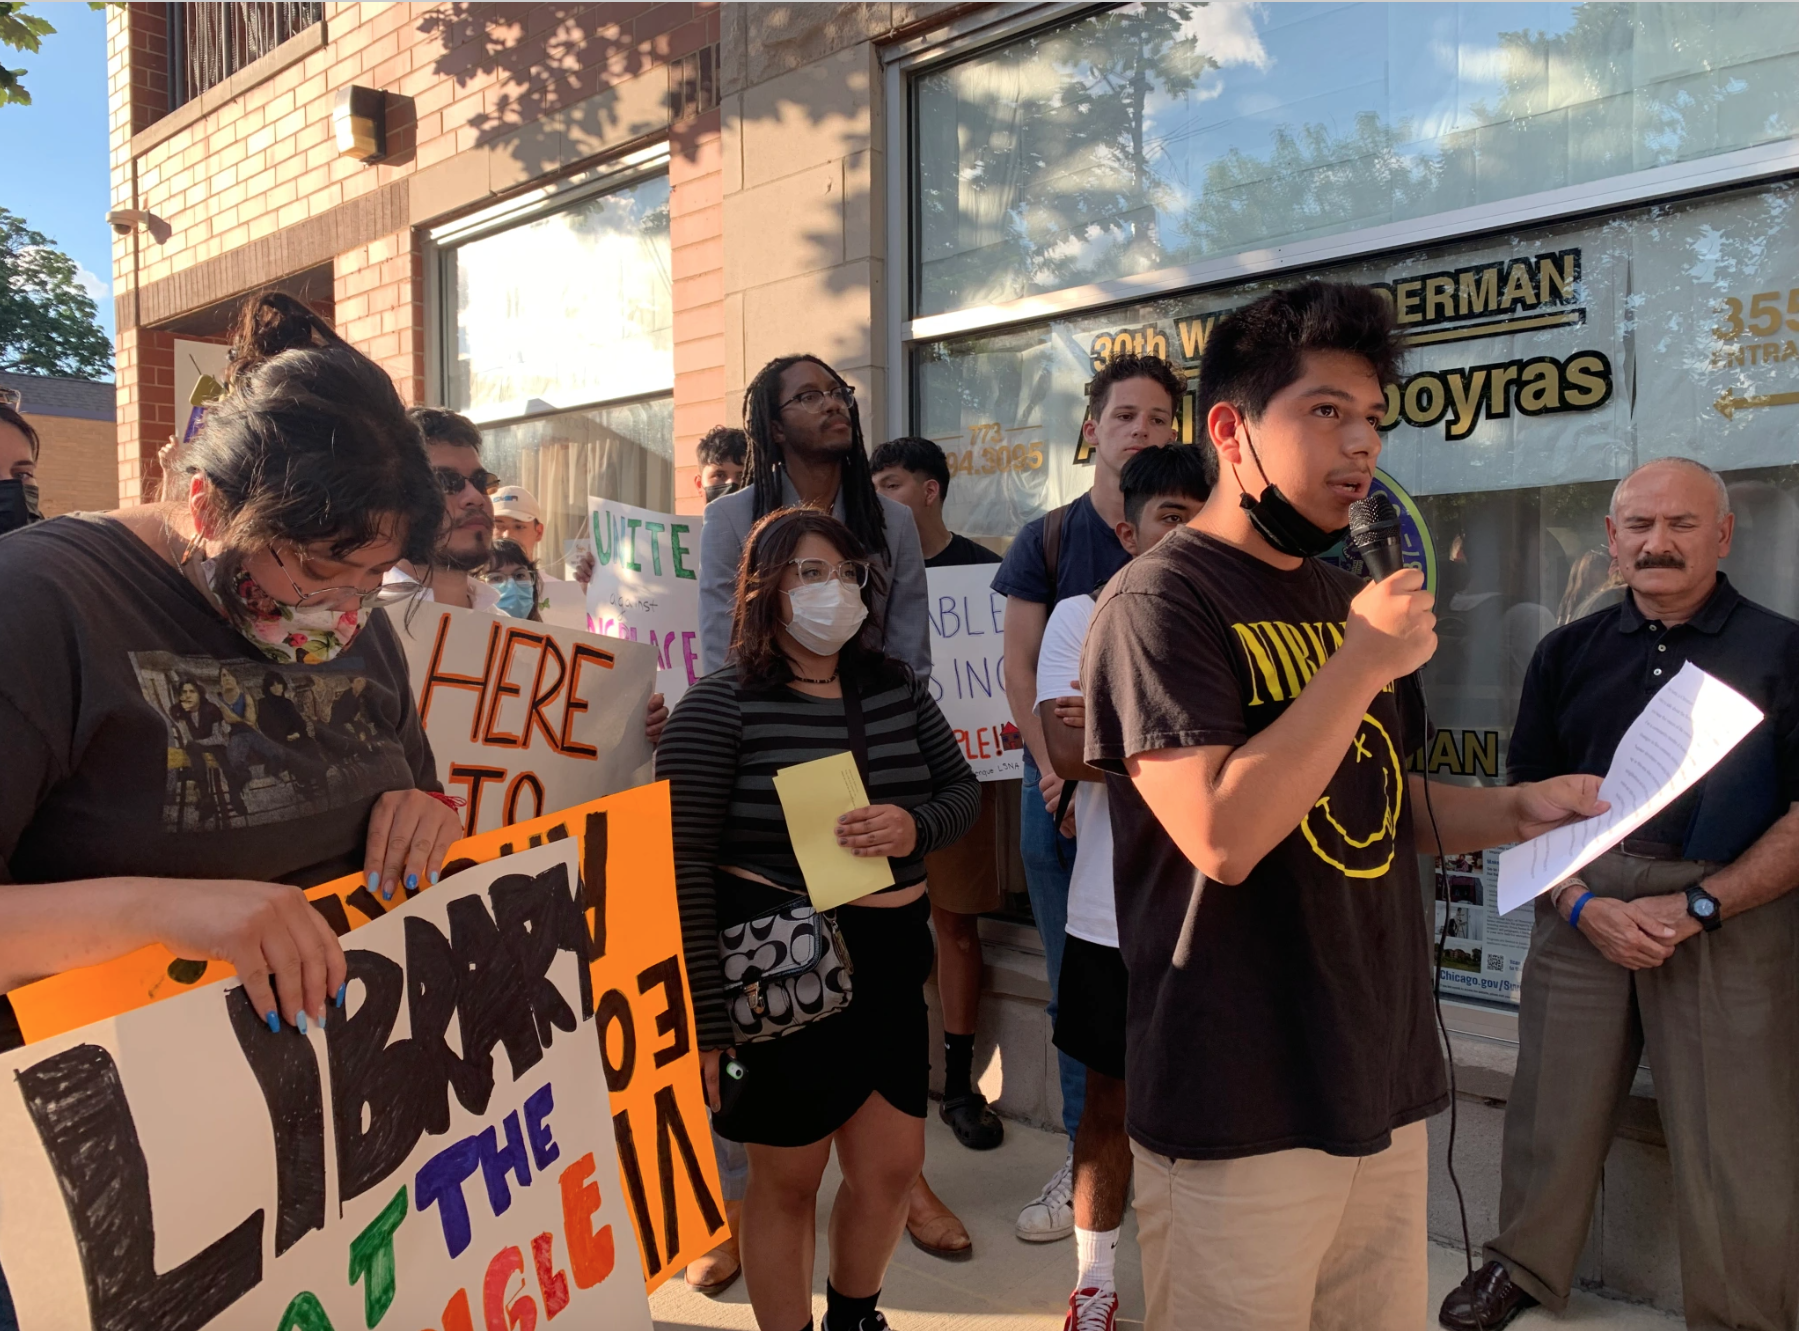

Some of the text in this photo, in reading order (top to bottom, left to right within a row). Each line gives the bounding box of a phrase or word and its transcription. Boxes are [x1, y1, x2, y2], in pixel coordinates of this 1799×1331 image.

[968, 422, 1004, 446] 773
[593, 511, 697, 580] UNITE
[419, 612, 615, 761] HERE
[414, 1082, 560, 1259] THE
